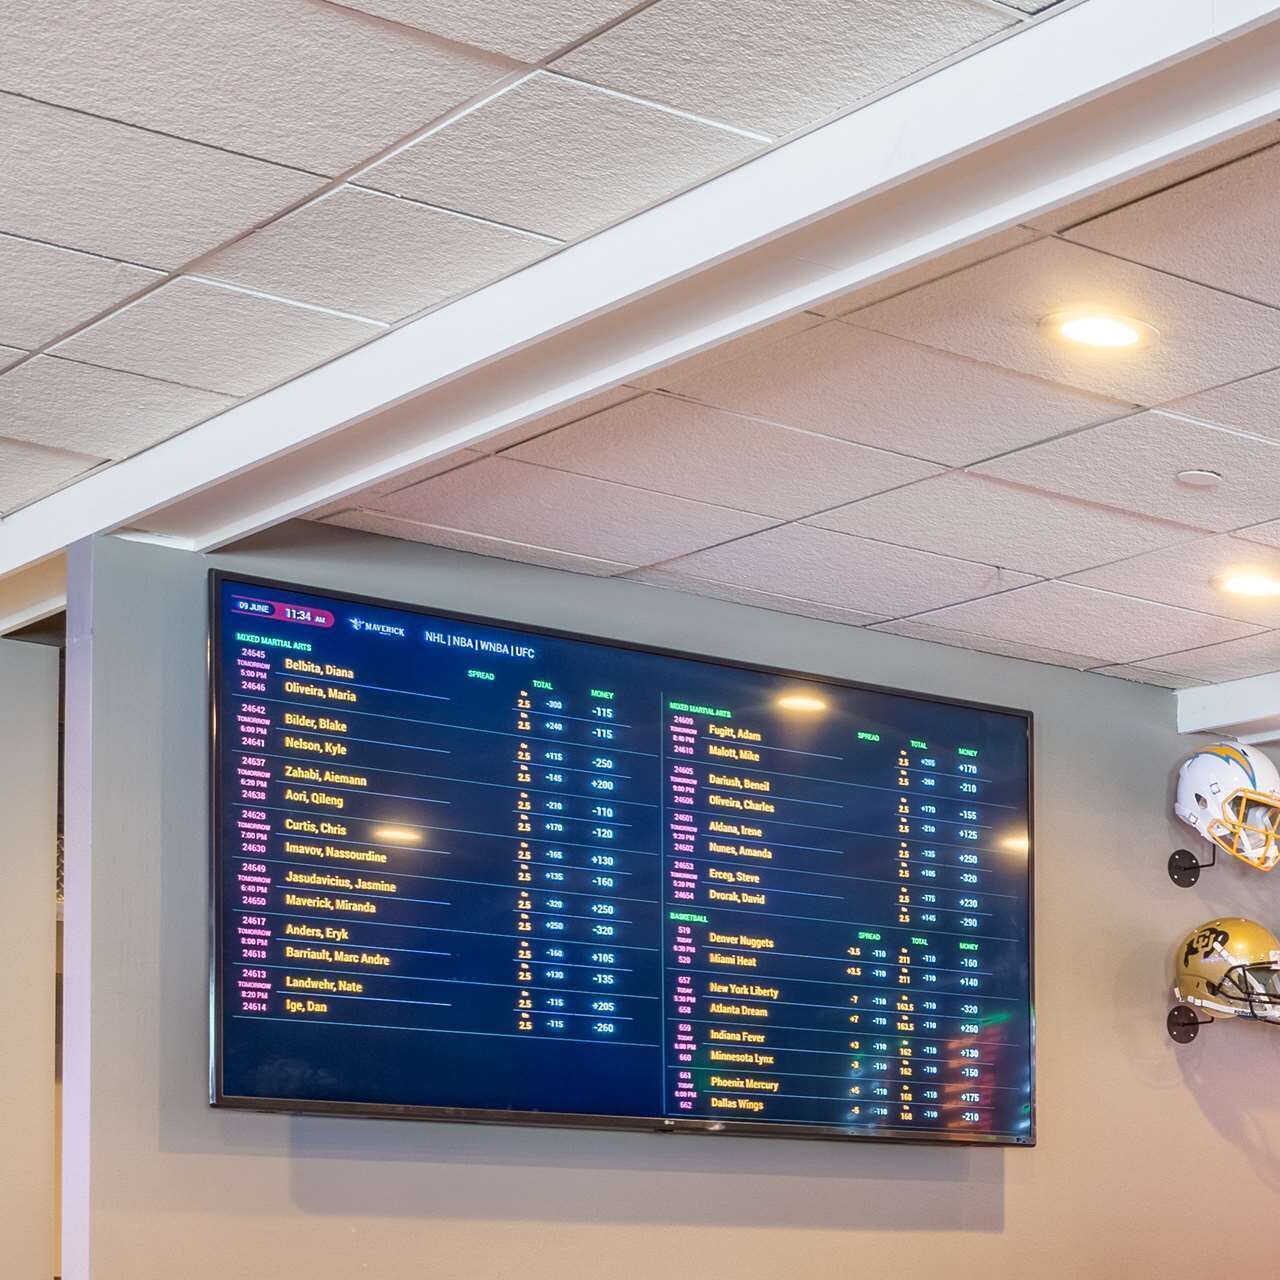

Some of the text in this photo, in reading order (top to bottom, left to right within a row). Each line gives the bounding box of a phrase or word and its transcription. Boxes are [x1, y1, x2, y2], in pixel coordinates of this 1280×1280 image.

[239, 601, 269, 613] 09 JUNE
[285, 608, 326, 624] 11:34 AM
[365, 622, 405, 636] MAVERICK
[237, 633, 311, 652] MIXED MARTIAL ARTS
[425, 631, 535, 658] NHL NBA WNBA UFC
[285, 659, 354, 678] Belbita, Diana
[468, 669, 495, 681] SPREAD
[285, 682, 356, 702] Oliveira, Maria
[533, 680, 553, 690] TOTAL
[591, 689, 613, 700] MONEY
[285, 714, 347, 732] Bilder, Blake
[709, 725, 761, 741] Fugitt, Adam
[285, 737, 347, 756] Nelson, Kyle
[709, 746, 760, 762] Malott, Mike
[285, 767, 367, 786] Zahabi, Aiemann
[709, 775, 770, 792] Dariush, Beneil
[592, 780, 613, 790] +200
[285, 790, 343, 808] Aori, Qileng
[709, 795, 774, 812] Oliveira, Charles
[285, 819, 346, 836] Curtis, Chris
[709, 822, 762, 837] Aldana, Irene
[286, 842, 386, 863] Imavov, Nassourdine
[709, 843, 772, 859] Nunes, Amanda
[286, 871, 396, 892] Jasudavicius, Jasmine
[709, 870, 760, 883] Erceg, Steve
[286, 895, 376, 914] Maverick, Miranda
[709, 890, 765, 905] Dvorak, David
[669, 912, 709, 923] BASKETBALL
[286, 925, 348, 941] Anders, Eryk
[710, 932, 774, 948] Denver Nuggets
[286, 947, 390, 966] Barriault, Marc Andre
[710, 954, 756, 967] Miami Heat
[286, 977, 363, 992] Landwehr, Nate
[710, 982, 778, 999] New York Liberty
[286, 1000, 327, 1013] Ige, Dan
[710, 1004, 768, 1017] Atlanta Dream
[710, 1029, 765, 1042] Indiana Fever
[710, 1051, 774, 1065] Minnesota Lynx
[711, 1077, 778, 1092] Phoenix Mercury
[711, 1098, 764, 1111] Dallas Wings
